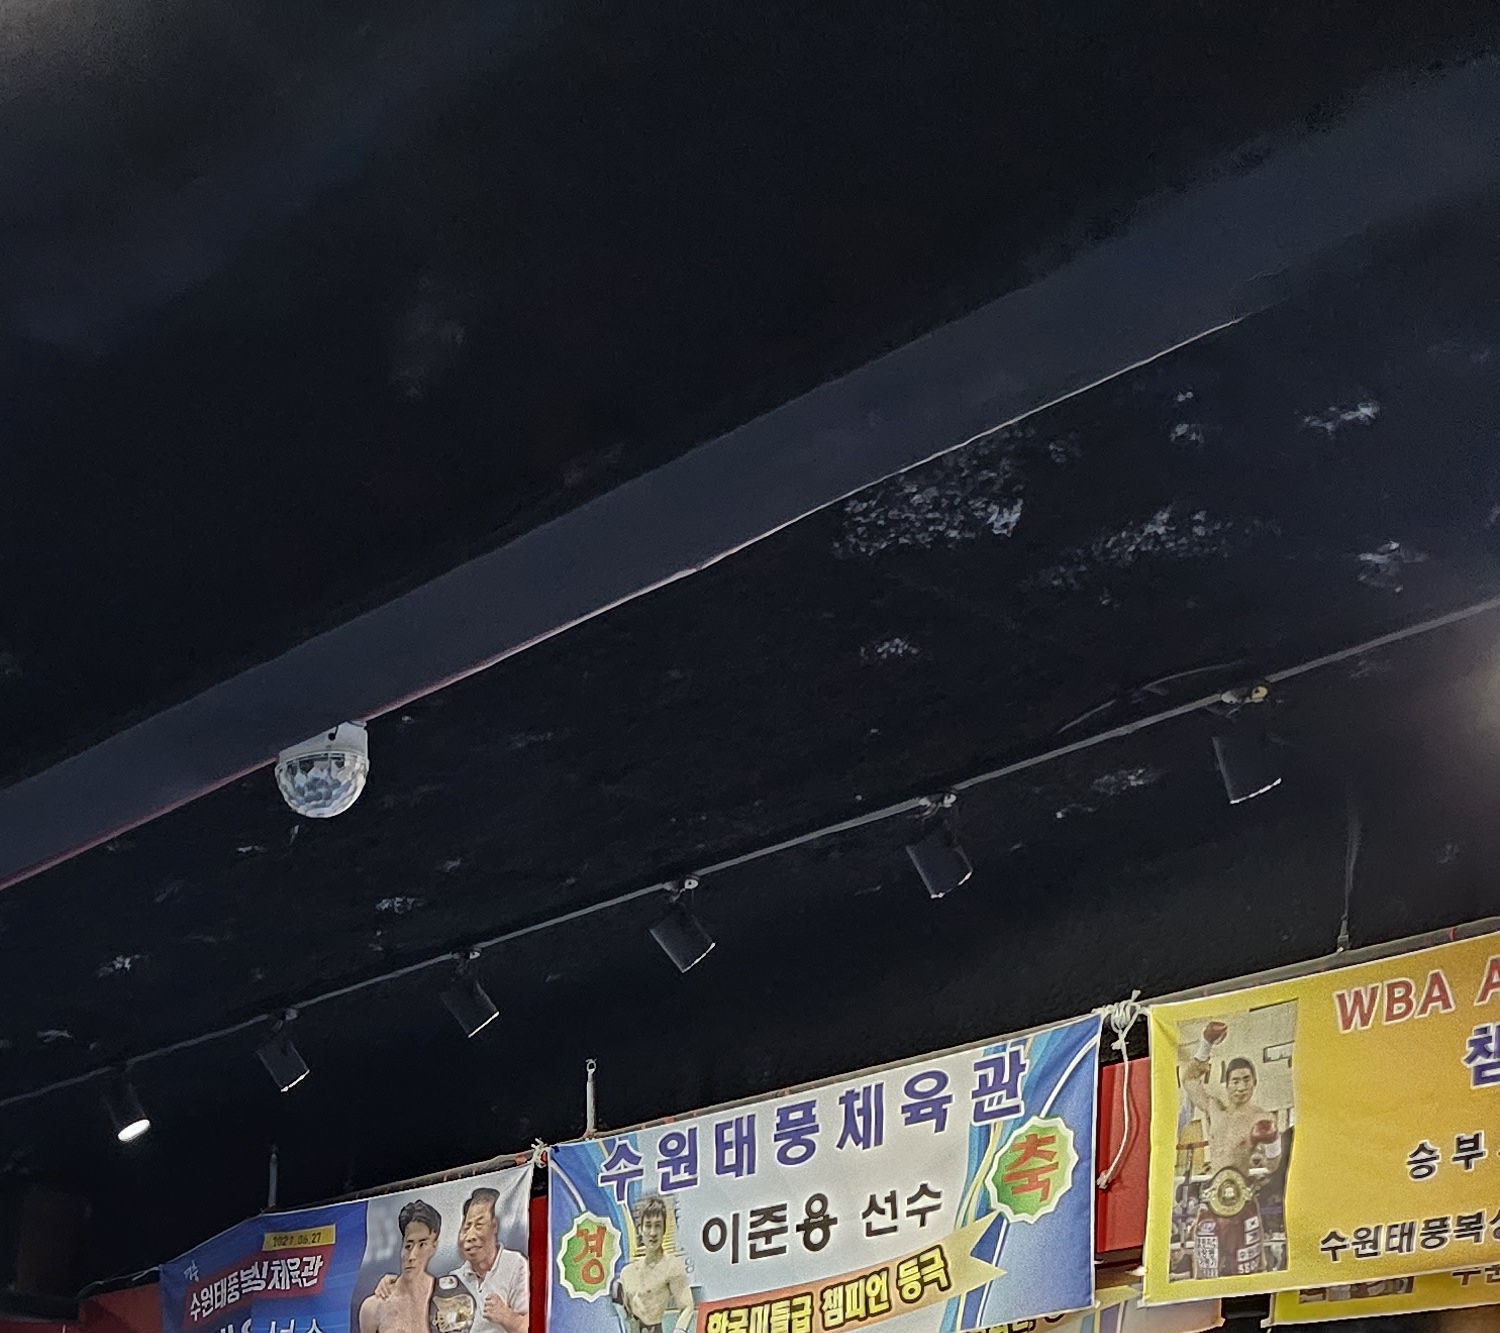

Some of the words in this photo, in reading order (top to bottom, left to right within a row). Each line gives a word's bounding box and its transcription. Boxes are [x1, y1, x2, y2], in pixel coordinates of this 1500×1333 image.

[1335, 970, 1454, 1031] WBA
[599, 1040, 1031, 1205] 수원태풍체육관
[1002, 1133, 1059, 1202] 축
[574, 1223, 606, 1285] 경
[701, 1192, 837, 1264] 이준용
[861, 1182, 943, 1238] 선수
[821, 1271, 889, 1328] 챔피언
[897, 1247, 949, 1302] 등극
